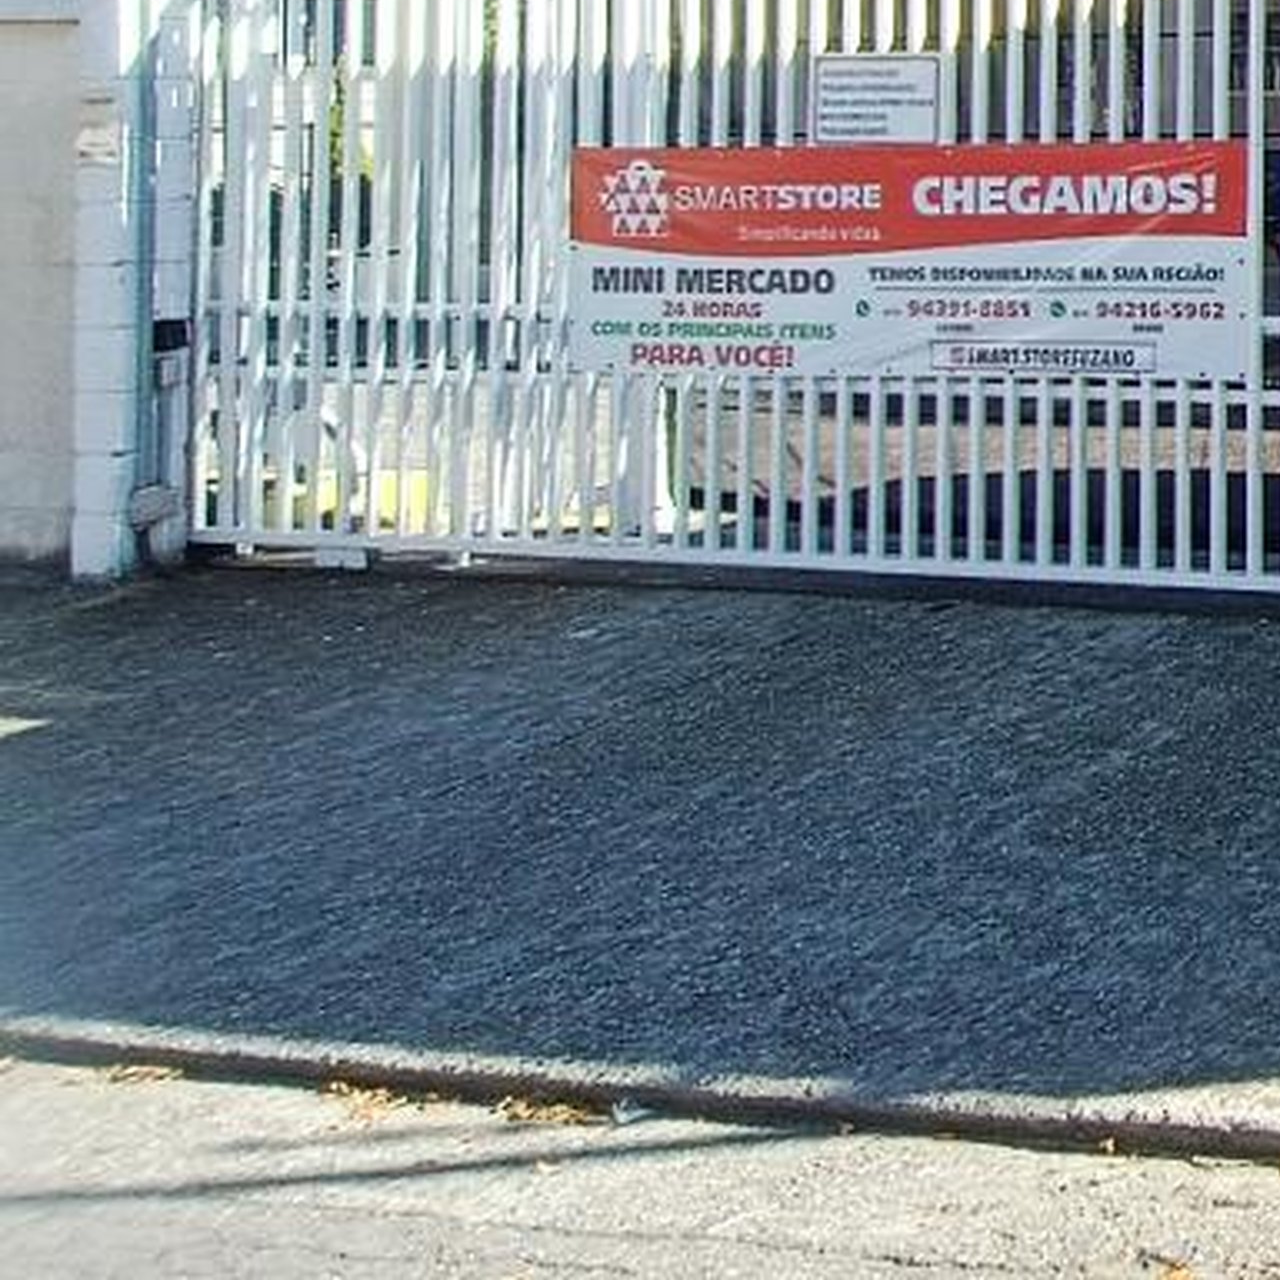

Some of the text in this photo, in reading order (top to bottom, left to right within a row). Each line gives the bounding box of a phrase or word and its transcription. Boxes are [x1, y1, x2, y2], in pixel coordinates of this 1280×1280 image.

[675, 184, 881, 211] SMARTSTORE
[912, 173, 1217, 216] CHEGAMOS!
[592, 266, 835, 295] MINI MERCADO
[1112, 266, 1148, 282] SUA
[661, 301, 762, 319] 24 HORAS
[591, 320, 837, 341] COM OS PRINCIPAIS ITENS
[630, 338, 795, 368] PARA VOCÊ!
